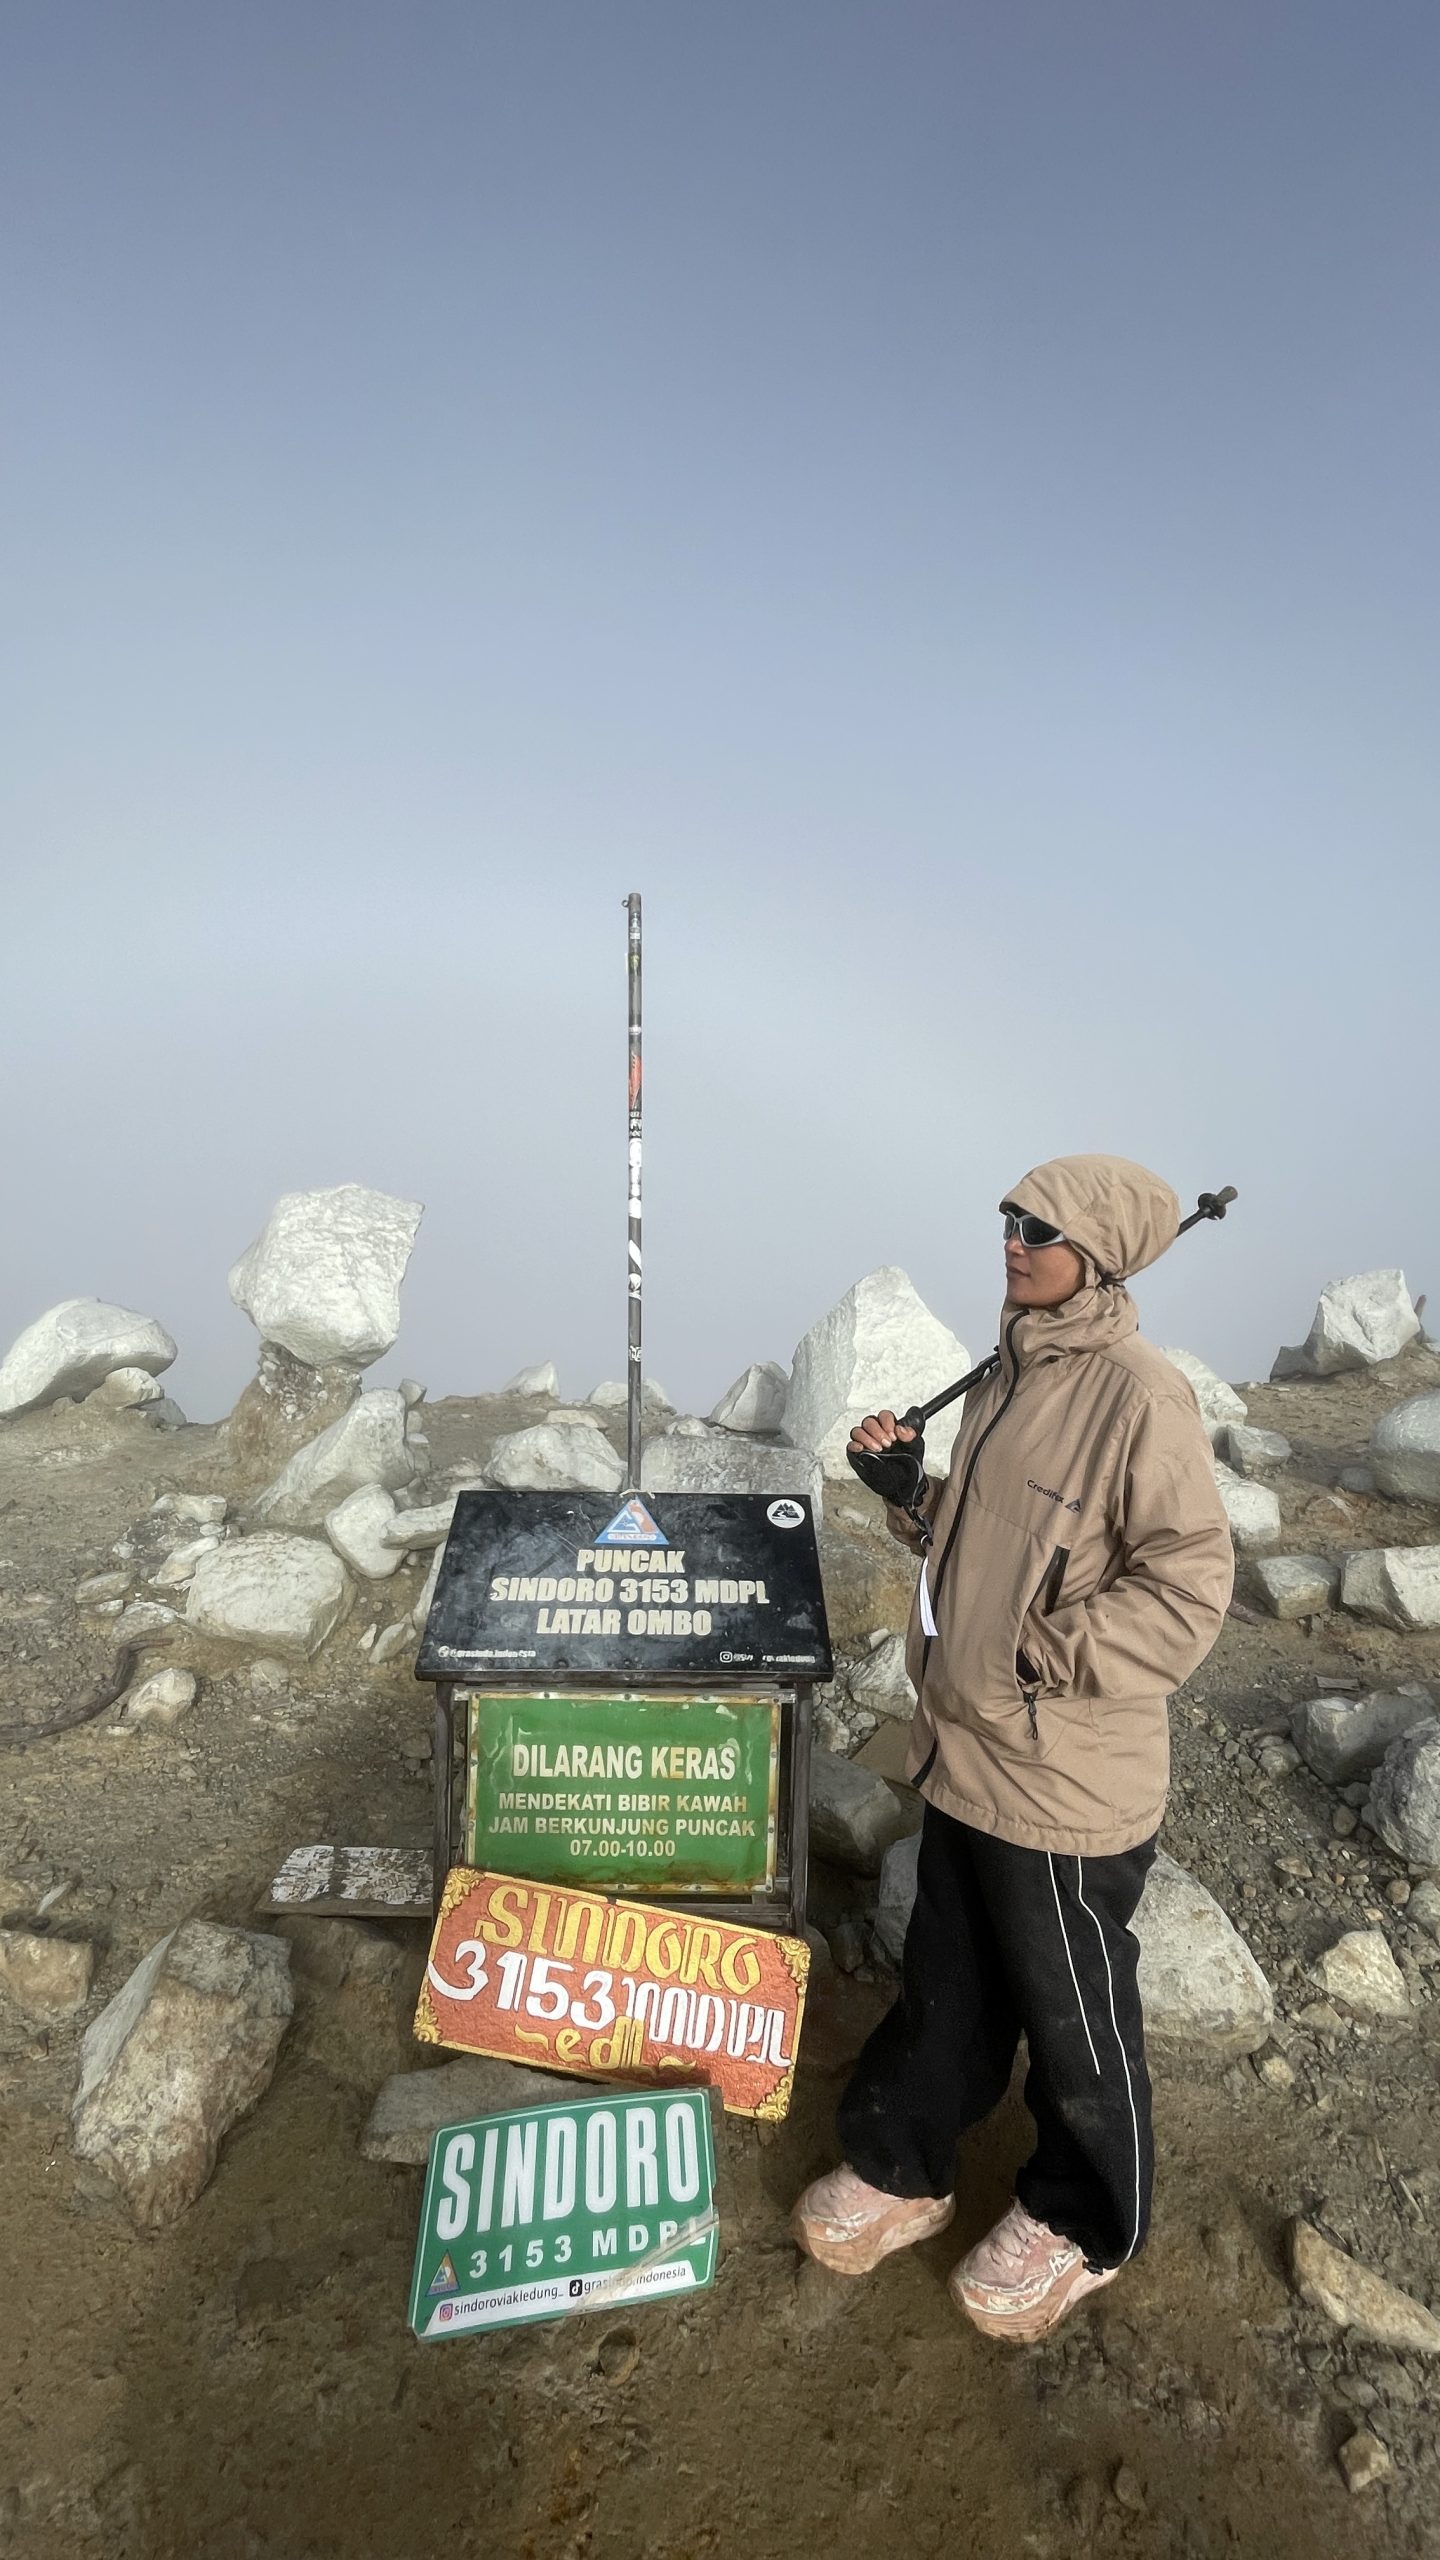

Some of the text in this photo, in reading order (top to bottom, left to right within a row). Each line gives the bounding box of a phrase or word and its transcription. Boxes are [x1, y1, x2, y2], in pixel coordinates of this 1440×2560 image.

[576, 1549, 685, 1573] PUNCAK
[490, 1577, 770, 1604] SINDORO 3153 MDPL
[536, 1608, 712, 1636] LATAR OMBO
[513, 1744, 736, 1780] DILARANG KERAS
[499, 1793, 747, 1813] MENDEKATI BIBIR KAWAH
[488, 1817, 756, 1837] JAM BERKUNJUNG PUNCAK
[570, 1839, 676, 1857] 07.00-10.00
[474, 1885, 761, 1994] SINDORO
[428, 1939, 616, 2031] 3153
[436, 2102, 700, 2240] SINDORO
[469, 2235, 572, 2279] 3153
